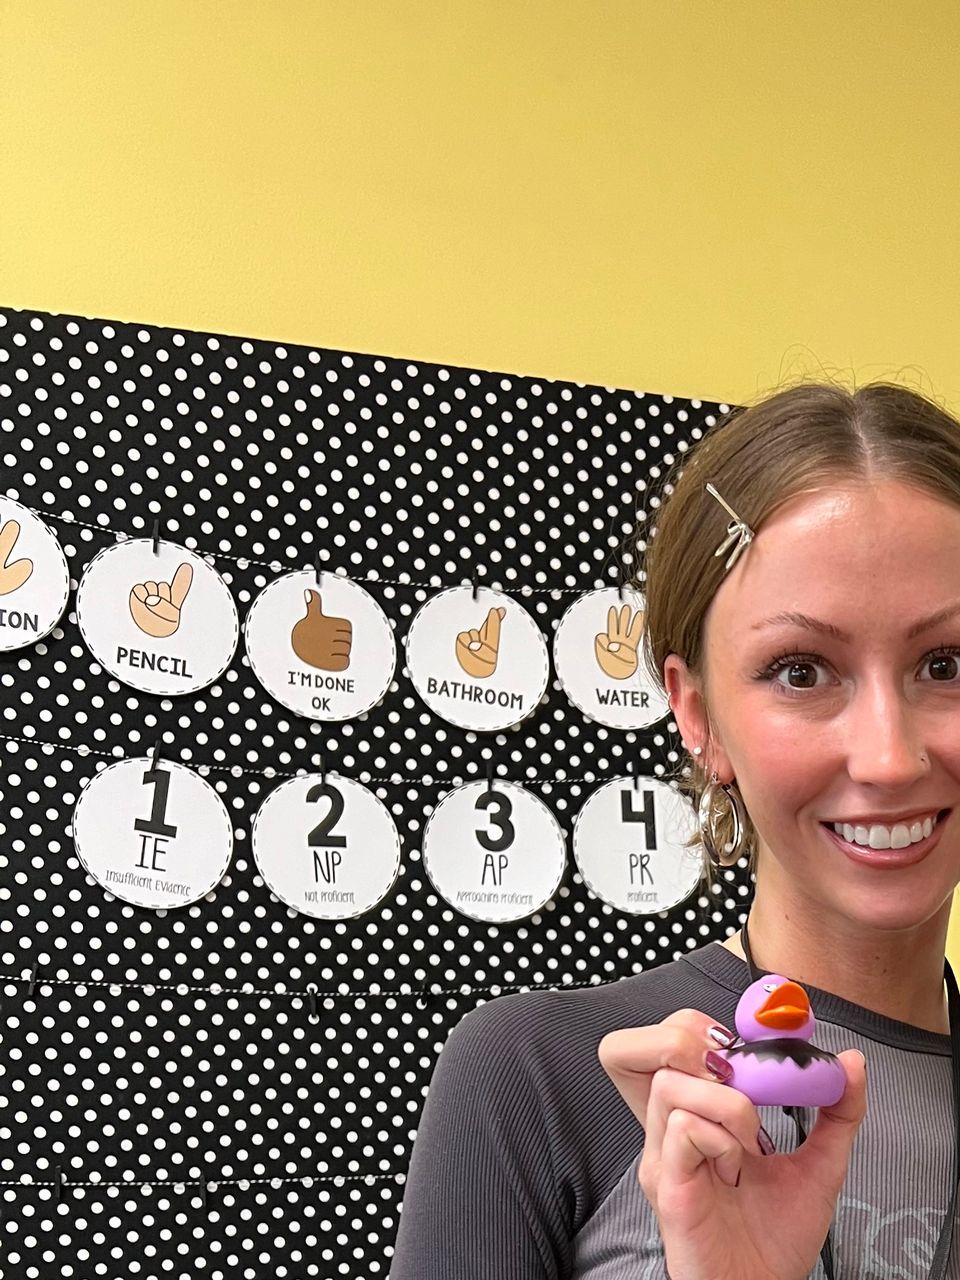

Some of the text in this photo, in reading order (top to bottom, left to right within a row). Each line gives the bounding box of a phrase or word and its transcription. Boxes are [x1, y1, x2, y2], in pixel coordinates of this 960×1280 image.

[116, 646, 193, 679] PENCIL
[288, 671, 355, 693] I'M DONE
[427, 677, 524, 711] BATHROOM
[595, 688, 650, 708] WATER
[312, 697, 332, 712] OK
[134, 769, 178, 838] 1
[306, 783, 347, 848] 2
[621, 790, 657, 851] 4
[475, 790, 515, 852] 3
[135, 834, 169, 872] IE
[313, 850, 342, 884] NP
[481, 854, 508, 886] AP
[629, 853, 654, 885] PR
